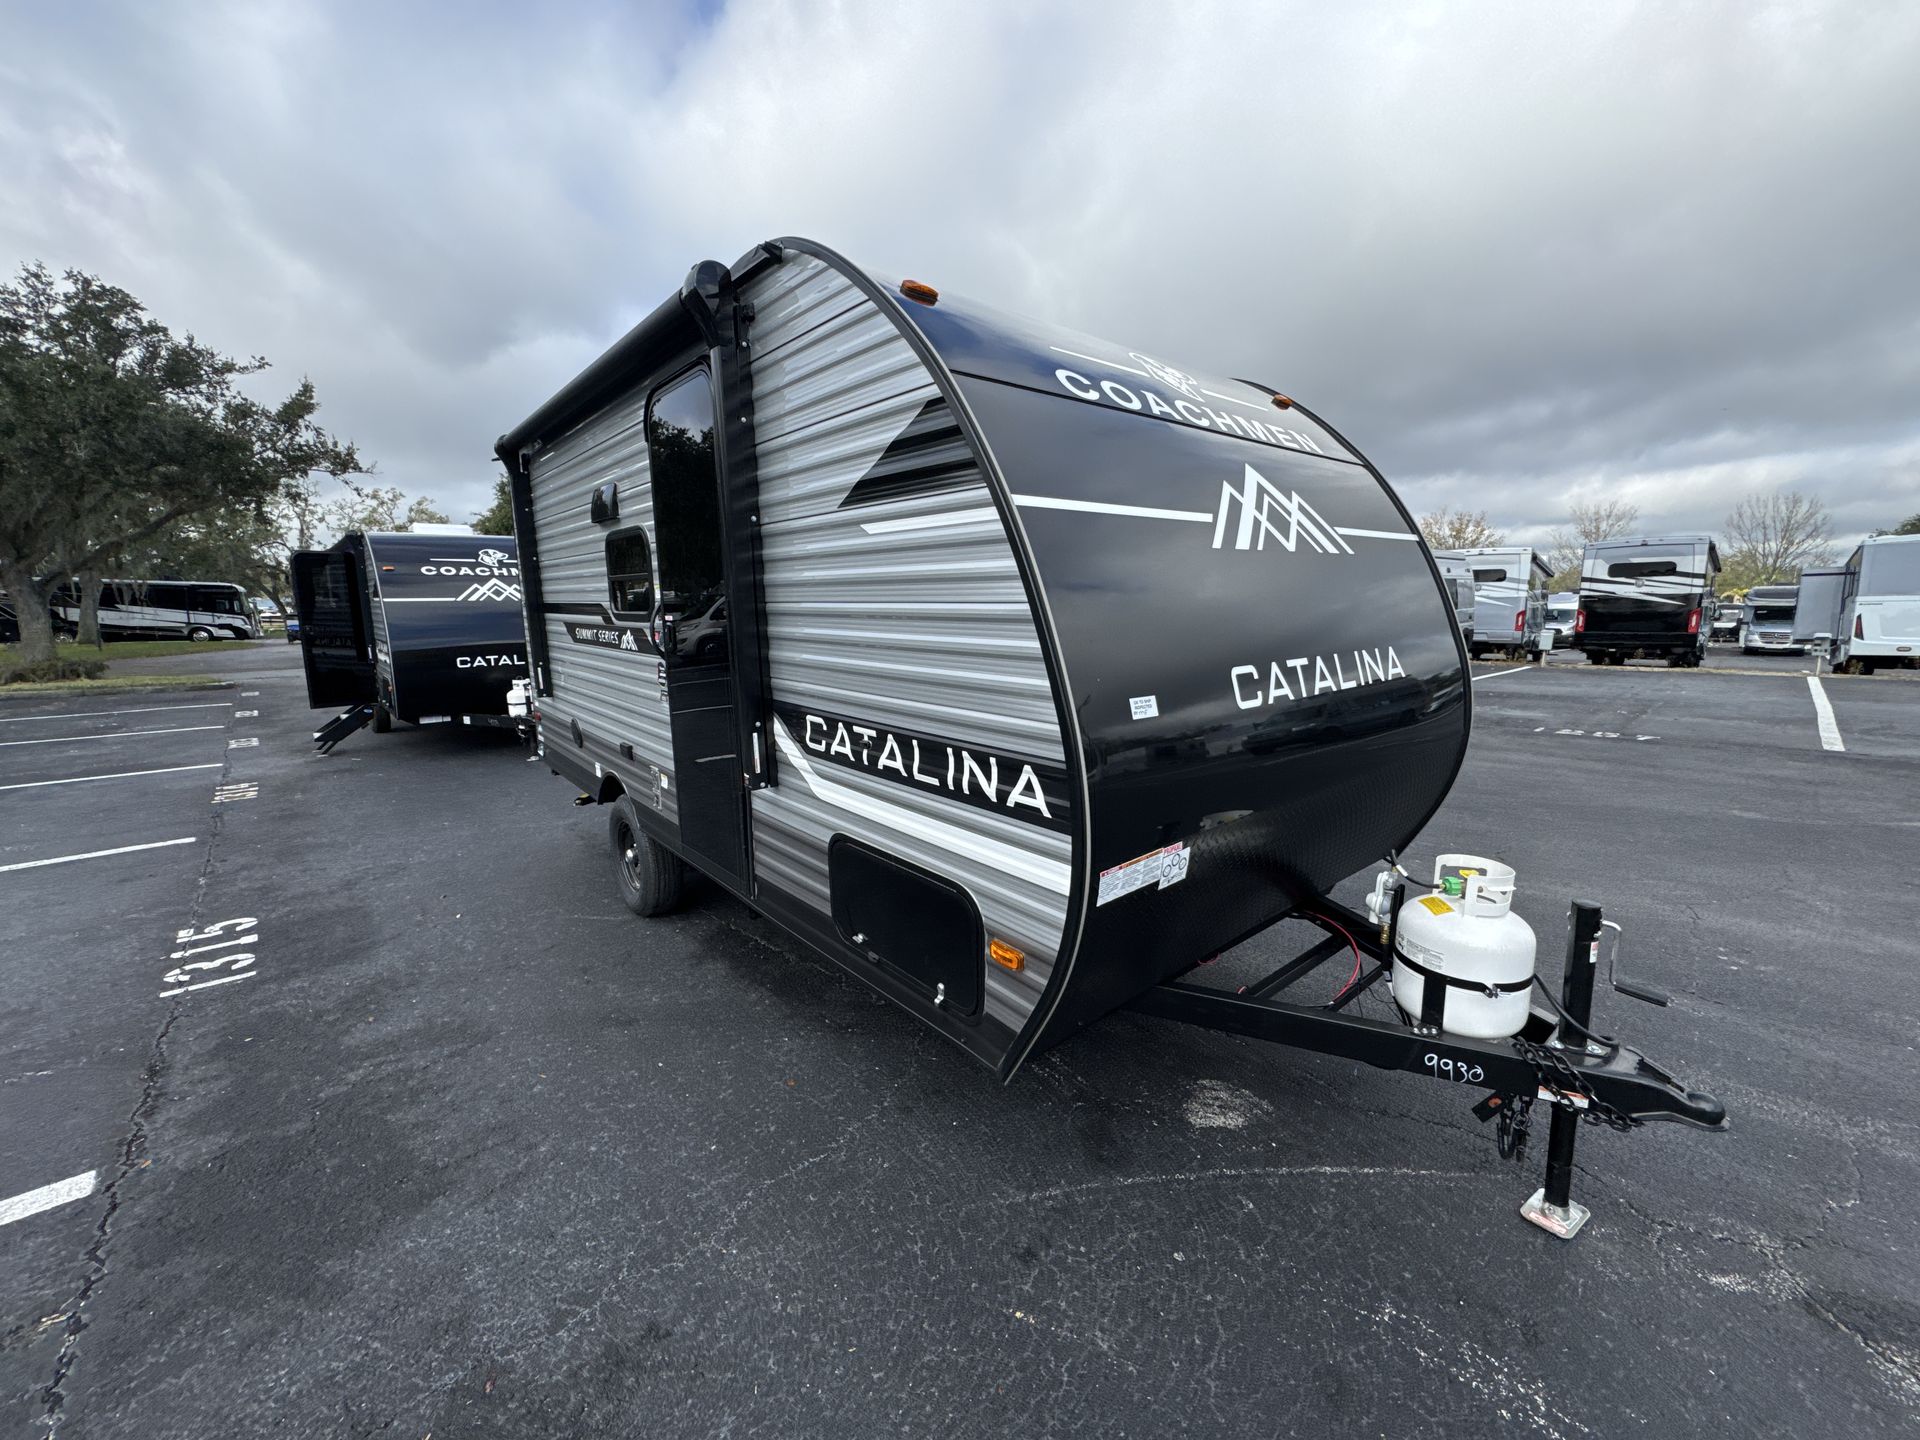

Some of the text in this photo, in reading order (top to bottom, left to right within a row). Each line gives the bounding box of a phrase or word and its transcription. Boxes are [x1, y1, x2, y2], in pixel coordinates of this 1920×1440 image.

[1055, 368, 1325, 454] COACHMEN
[575, 627, 620, 645] SUMMIT SERIES
[456, 654, 526, 668] CATAL
[1230, 645, 1407, 710] CATALINA
[804, 714, 1053, 819] CATALINA
[1424, 1053, 1484, 1083] 9930
